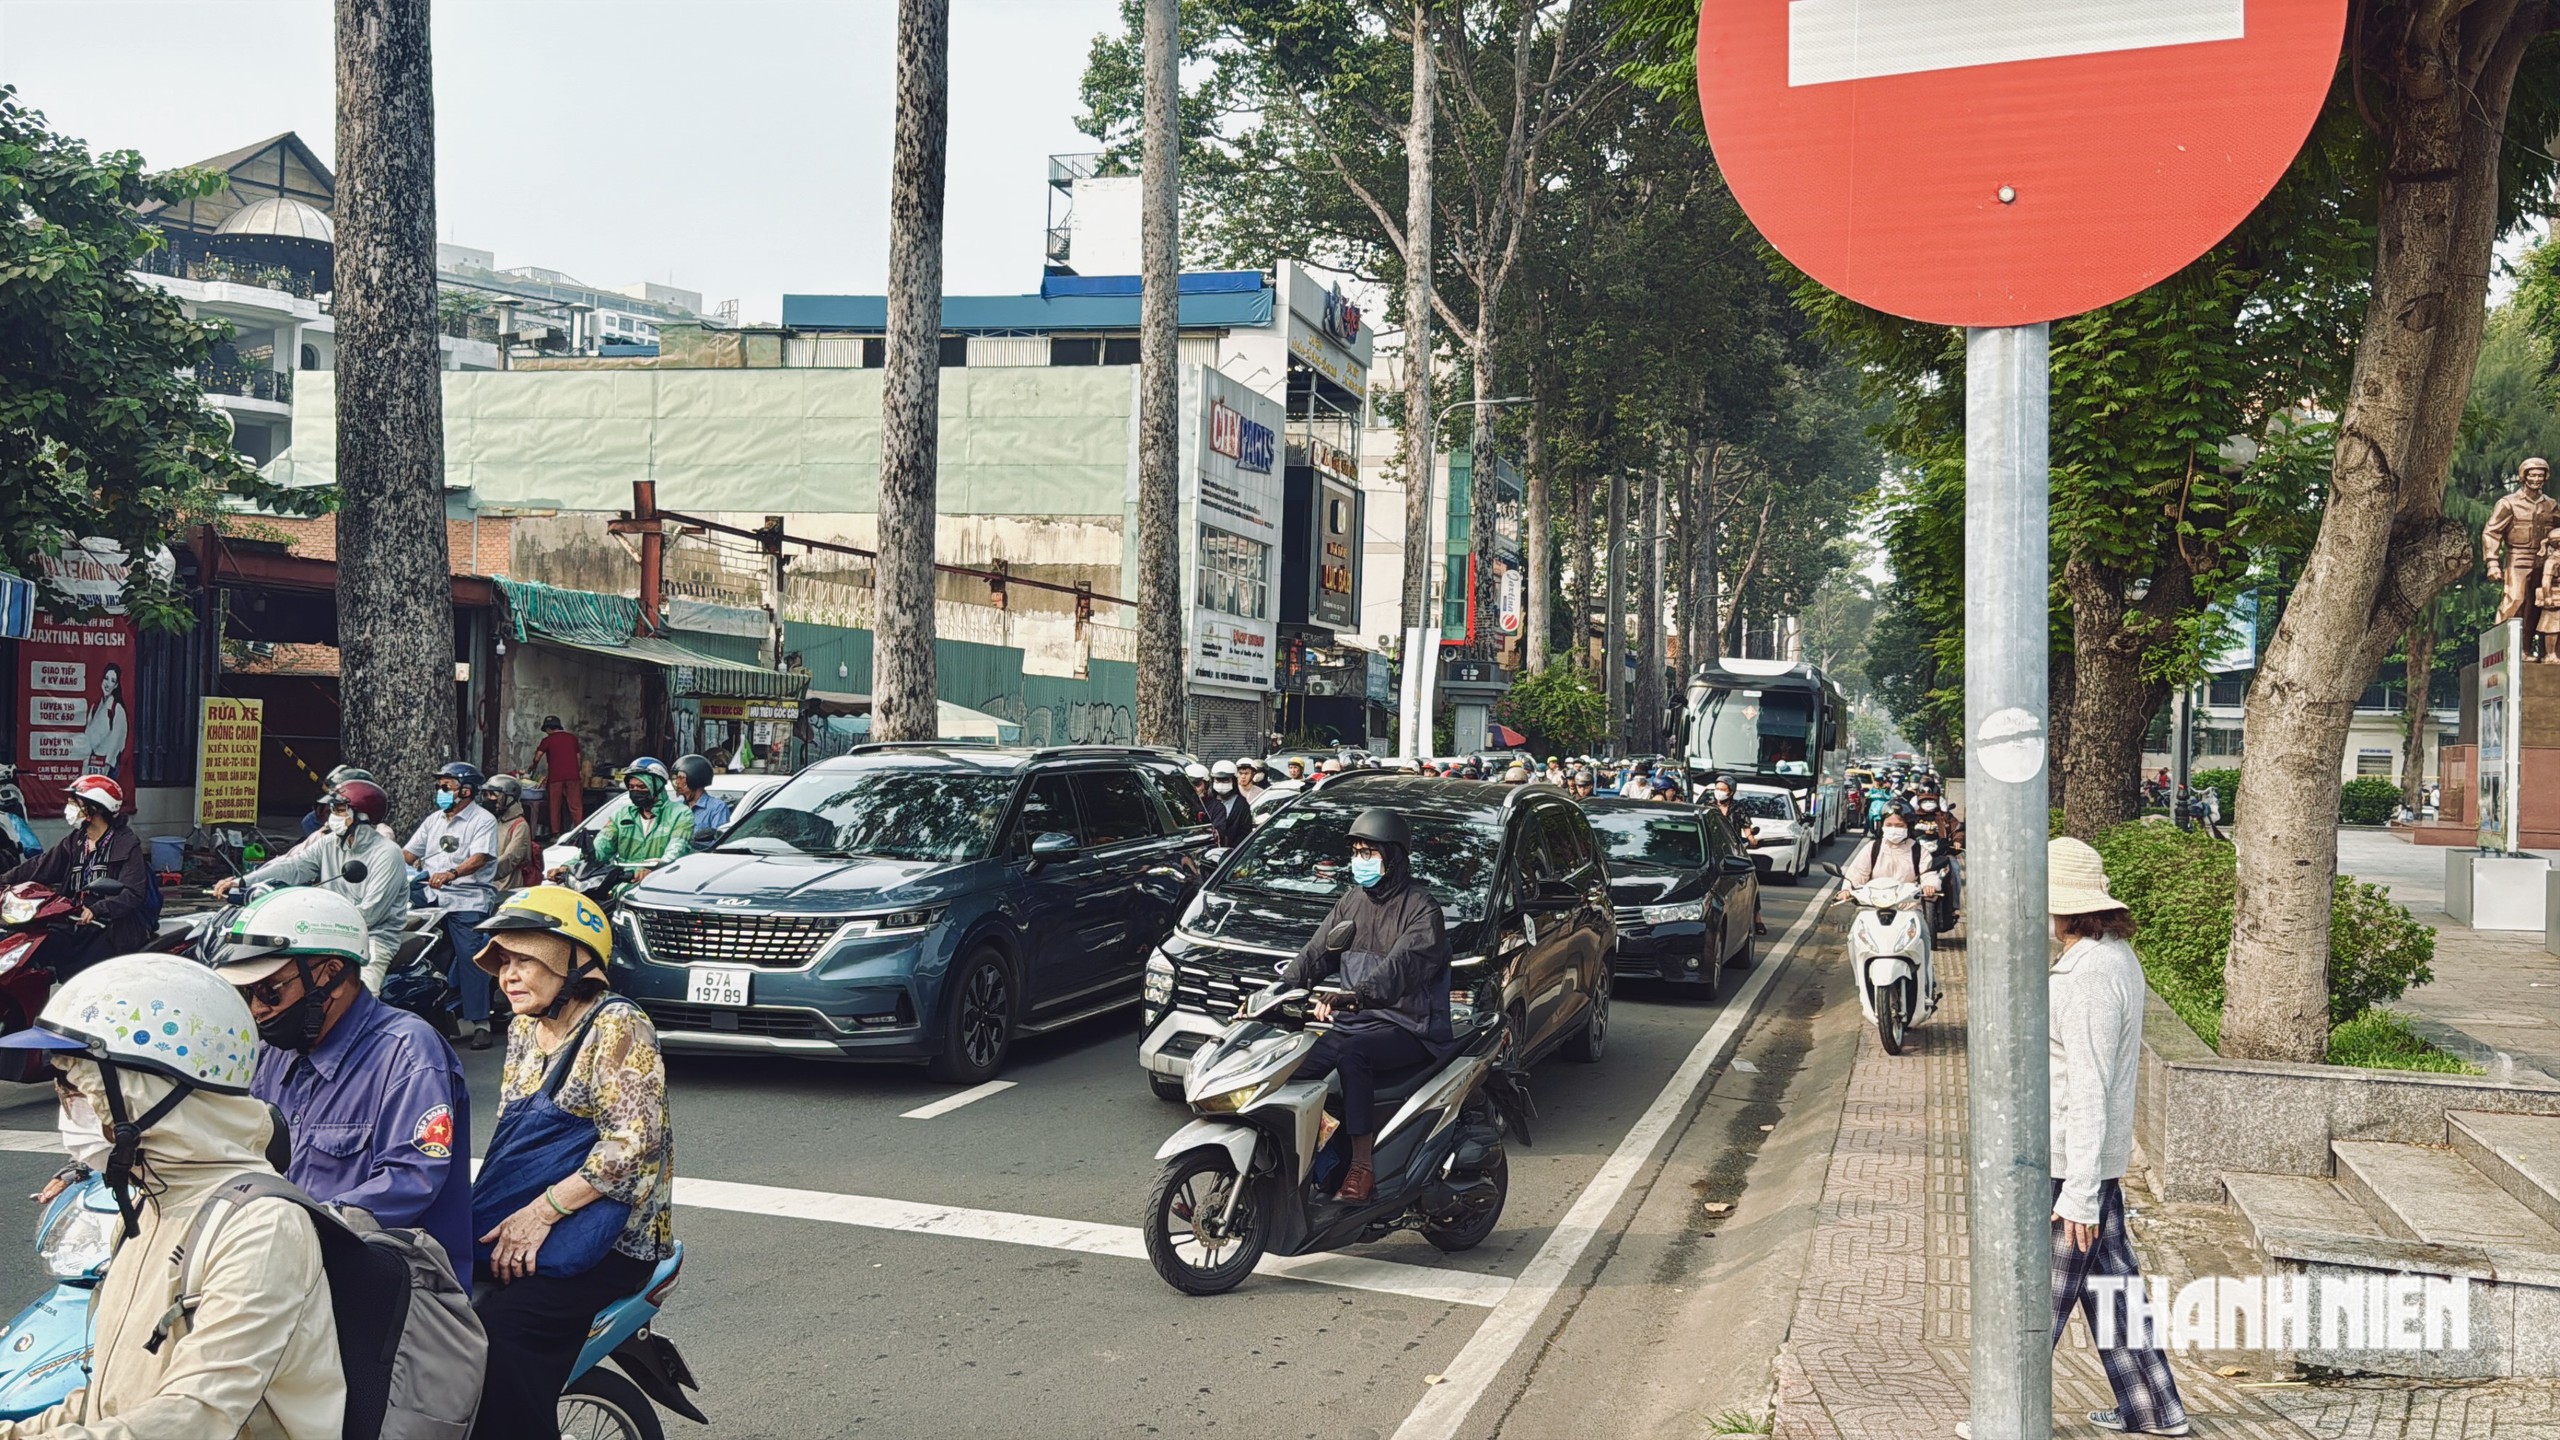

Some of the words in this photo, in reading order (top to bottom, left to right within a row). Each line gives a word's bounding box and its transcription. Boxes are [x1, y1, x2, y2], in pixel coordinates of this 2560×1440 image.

[1213, 404, 1241, 458] CITY
[31, 628, 80, 645] JAXTINA
[83, 631, 126, 646] ENGLISH
[41, 666, 60, 676] GIAO
[39, 712, 60, 721] TOEIC
[60, 713, 75, 722] 650
[208, 702, 237, 721] RỬA
[241, 706, 259, 721] XE
[207, 722, 234, 740] KHÔNG
[39, 747, 58, 756] IELTS
[577, 901, 604, 933] be
[706, 971, 731, 987] 67A
